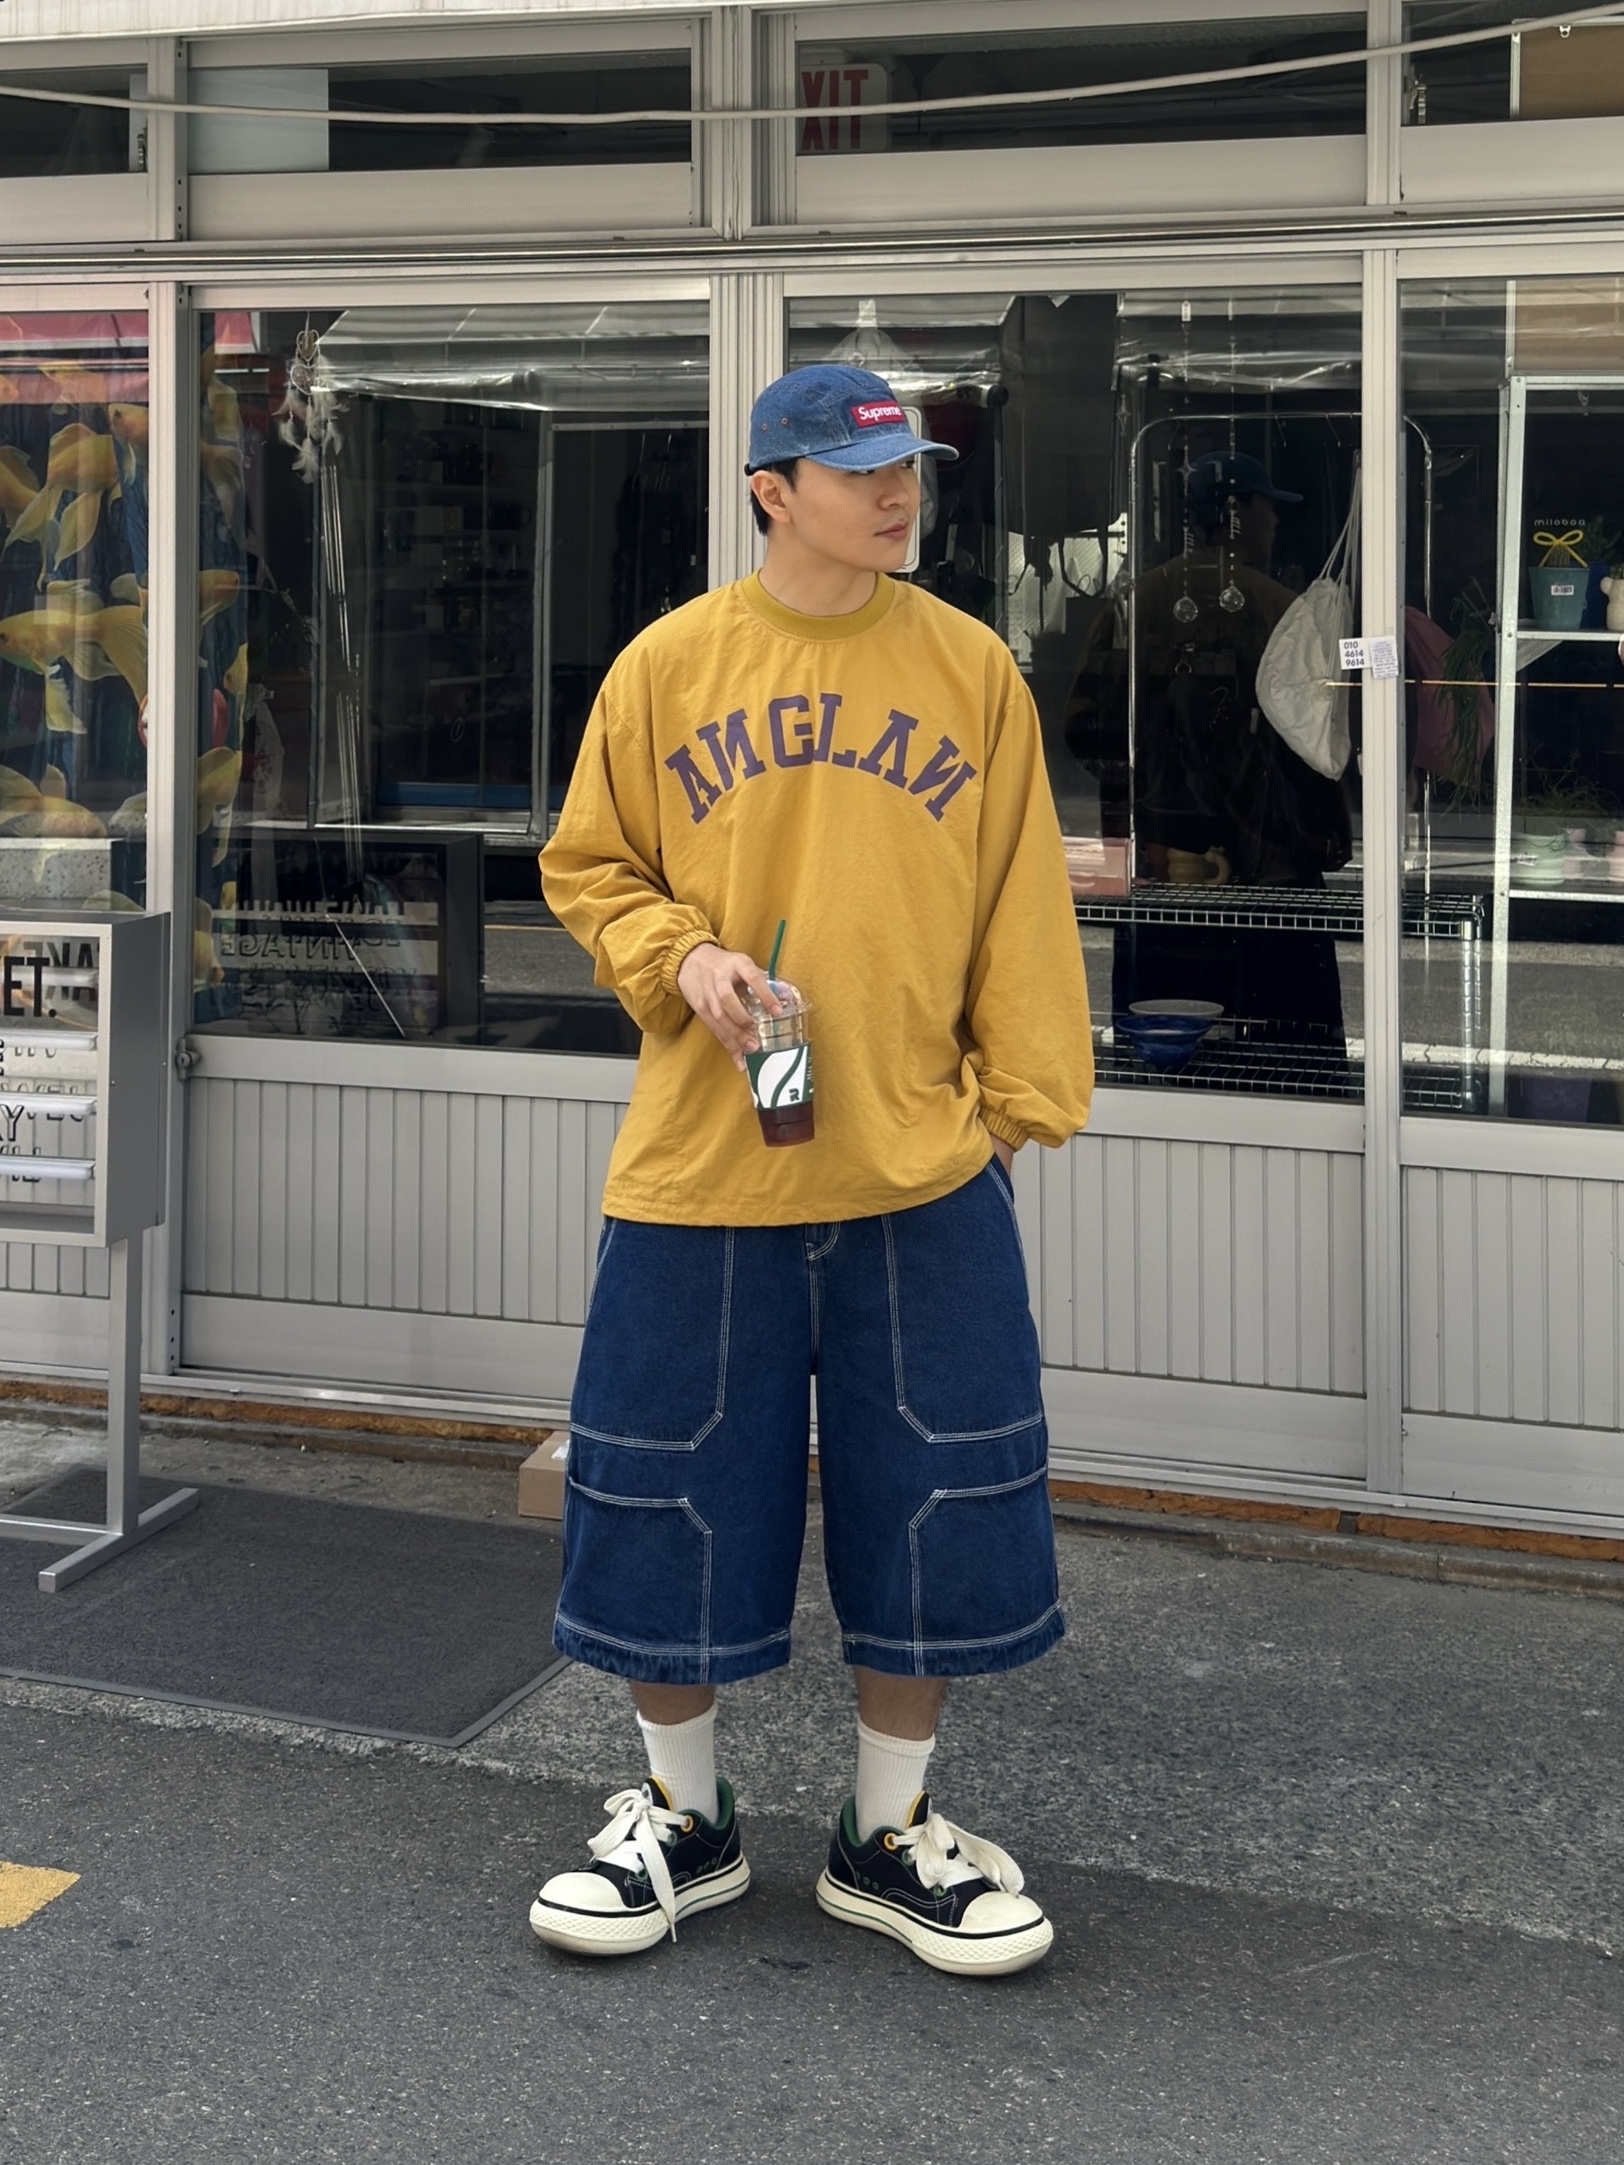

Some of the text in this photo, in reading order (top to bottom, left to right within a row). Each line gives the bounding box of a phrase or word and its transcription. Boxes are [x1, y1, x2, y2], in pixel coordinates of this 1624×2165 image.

[858, 406, 902, 422] Supreme
[1343, 641, 1359, 650] 010
[1344, 649, 1364, 658] 4614
[1345, 658, 1365, 667] 9614
